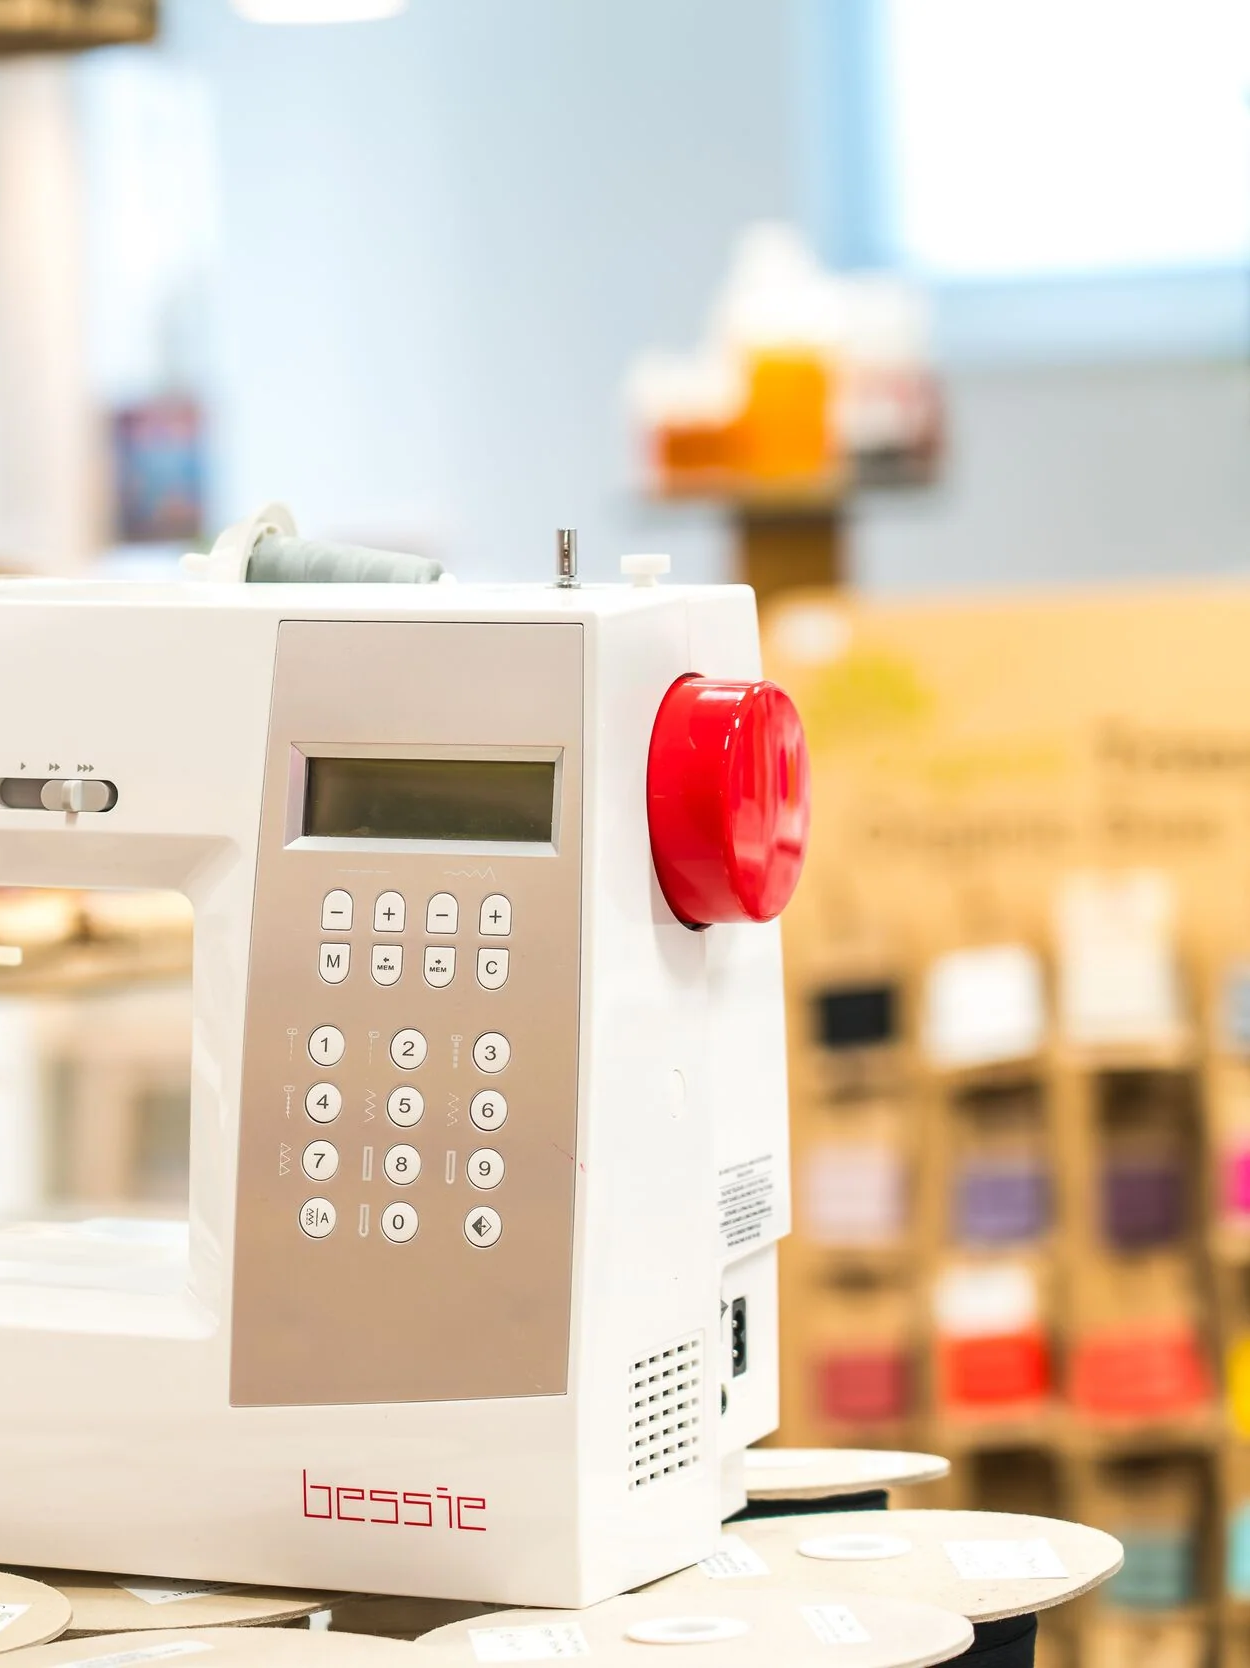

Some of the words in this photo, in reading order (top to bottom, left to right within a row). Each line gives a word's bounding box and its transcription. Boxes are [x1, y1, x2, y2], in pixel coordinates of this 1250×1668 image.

[326, 954, 341, 969] M
[485, 960, 498, 975] C
[401, 1040, 415, 1057] 2
[484, 1045, 497, 1061] 3
[316, 1094, 329, 1110] 4
[398, 1097, 411, 1114] 5
[481, 1102, 494, 1119] 6
[313, 1153, 326, 1169] 7
[395, 1156, 408, 1172] 8
[478, 1160, 491, 1177] 9
[392, 1214, 405, 1230] 0
[303, 1469, 487, 1532] bessie
